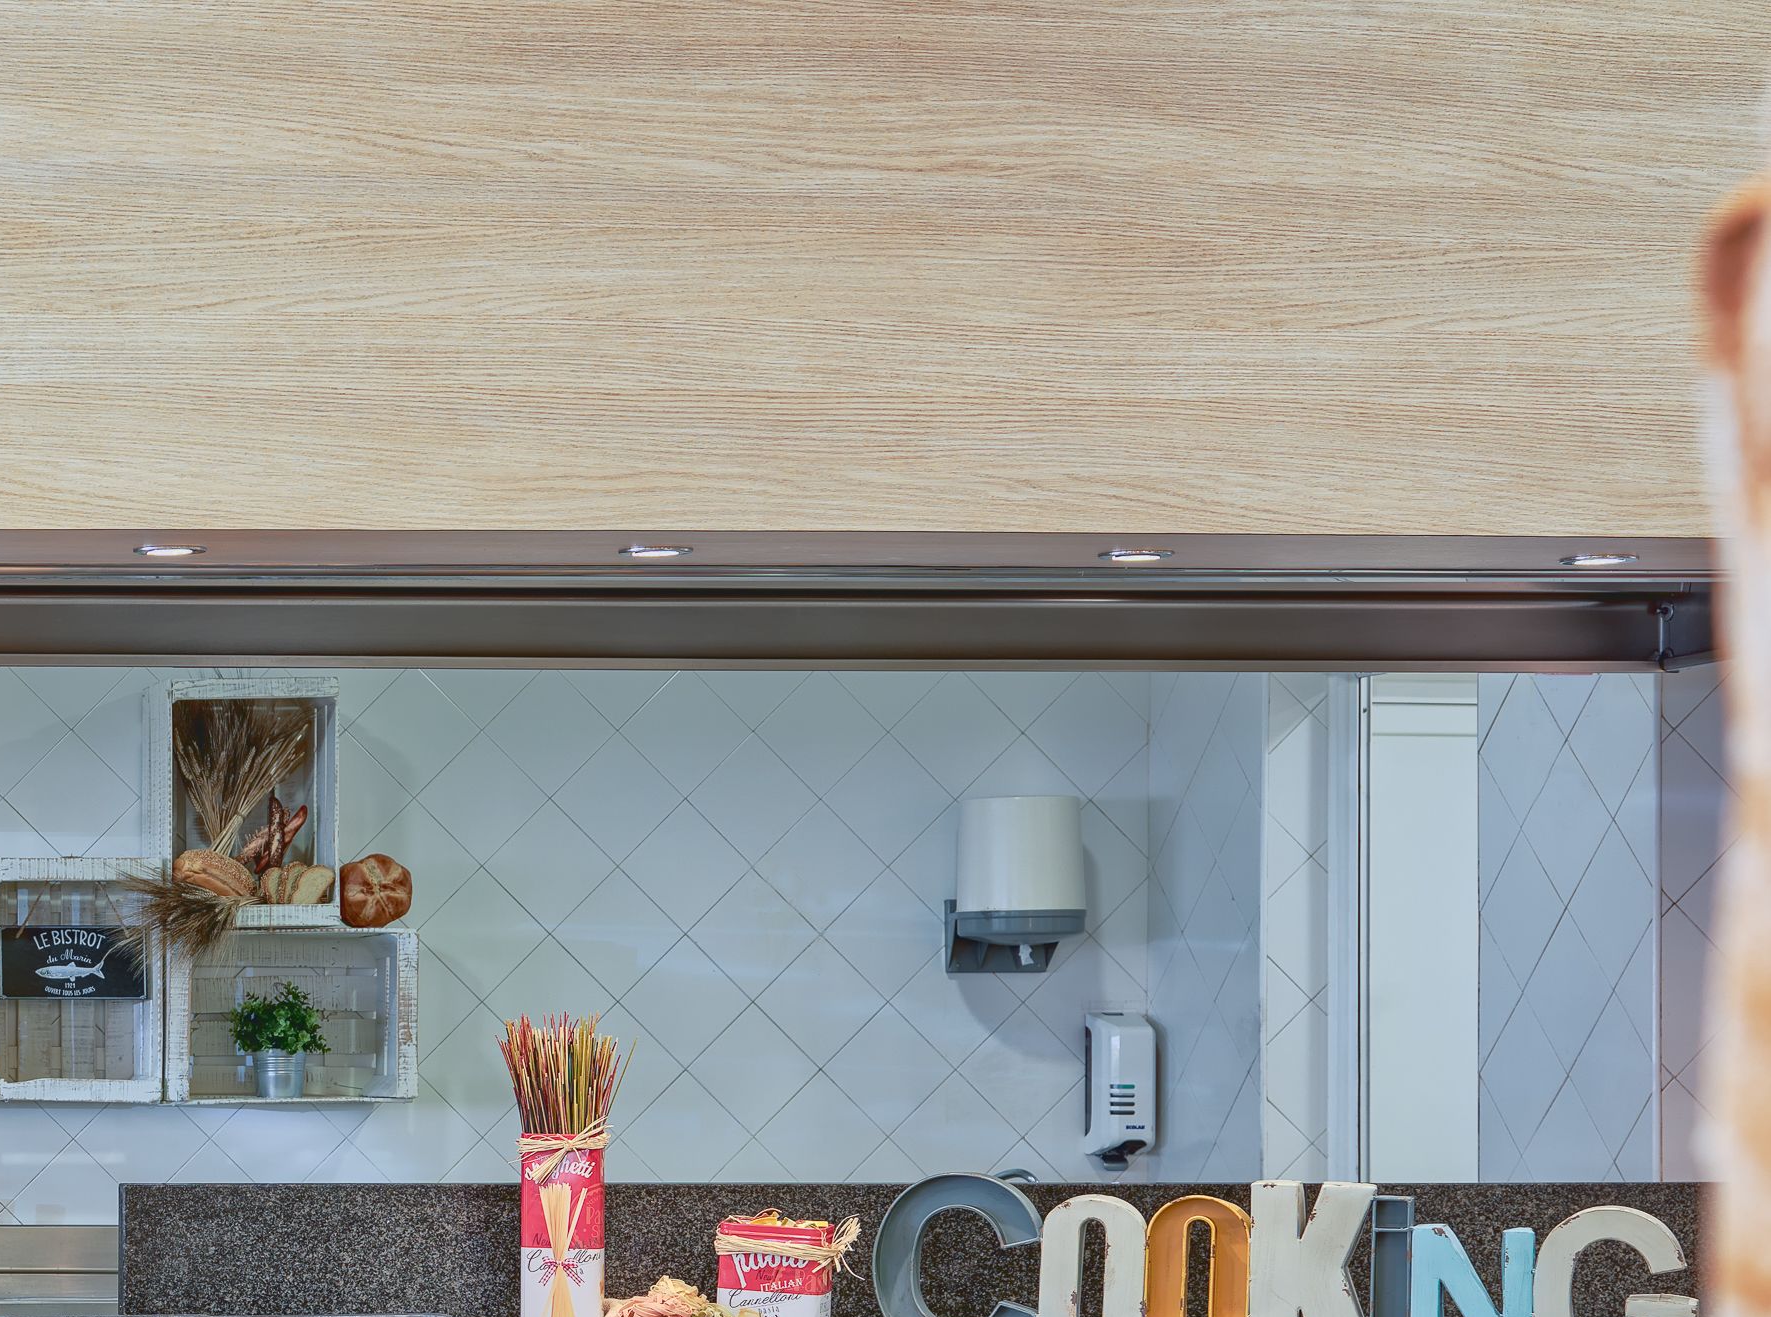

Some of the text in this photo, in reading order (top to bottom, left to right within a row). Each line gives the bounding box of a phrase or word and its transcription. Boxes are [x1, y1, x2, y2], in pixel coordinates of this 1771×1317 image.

[33, 929, 106, 950] LE BISTROT
[46, 955, 58, 964] du
[760, 1278, 803, 1292] ITALIAN
[729, 1288, 802, 1309] Cannelloni
